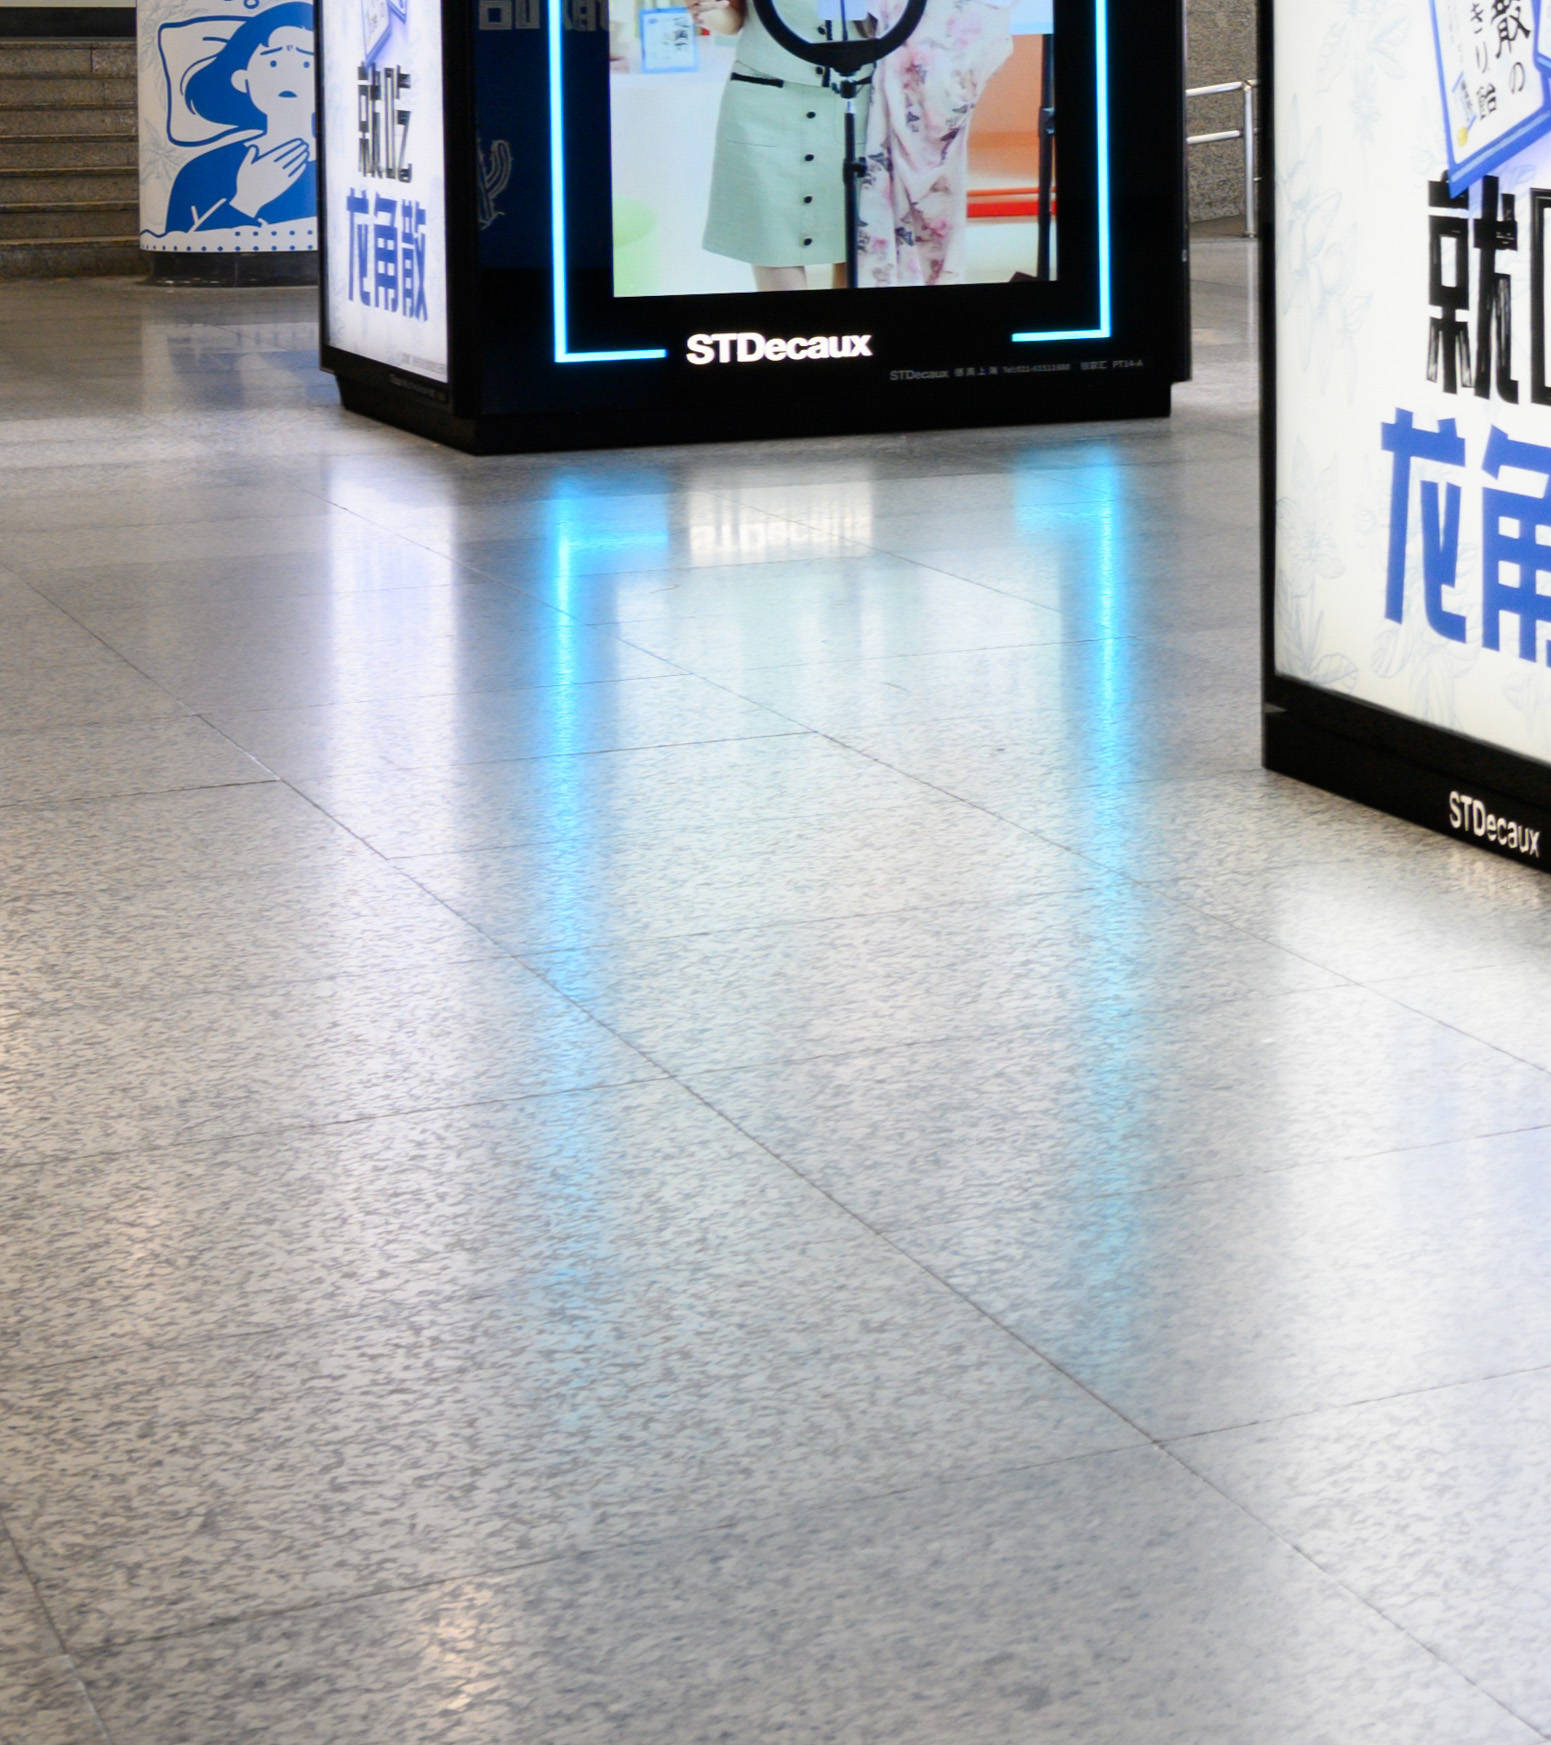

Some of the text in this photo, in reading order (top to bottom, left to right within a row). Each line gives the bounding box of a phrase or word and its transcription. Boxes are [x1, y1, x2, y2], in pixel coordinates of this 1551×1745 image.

[357, 60, 412, 184] 就吃
[346, 187, 429, 322] 龙角散
[686, 332, 873, 366] STDecaux
[1449, 789, 1541, 859] STDecaux
